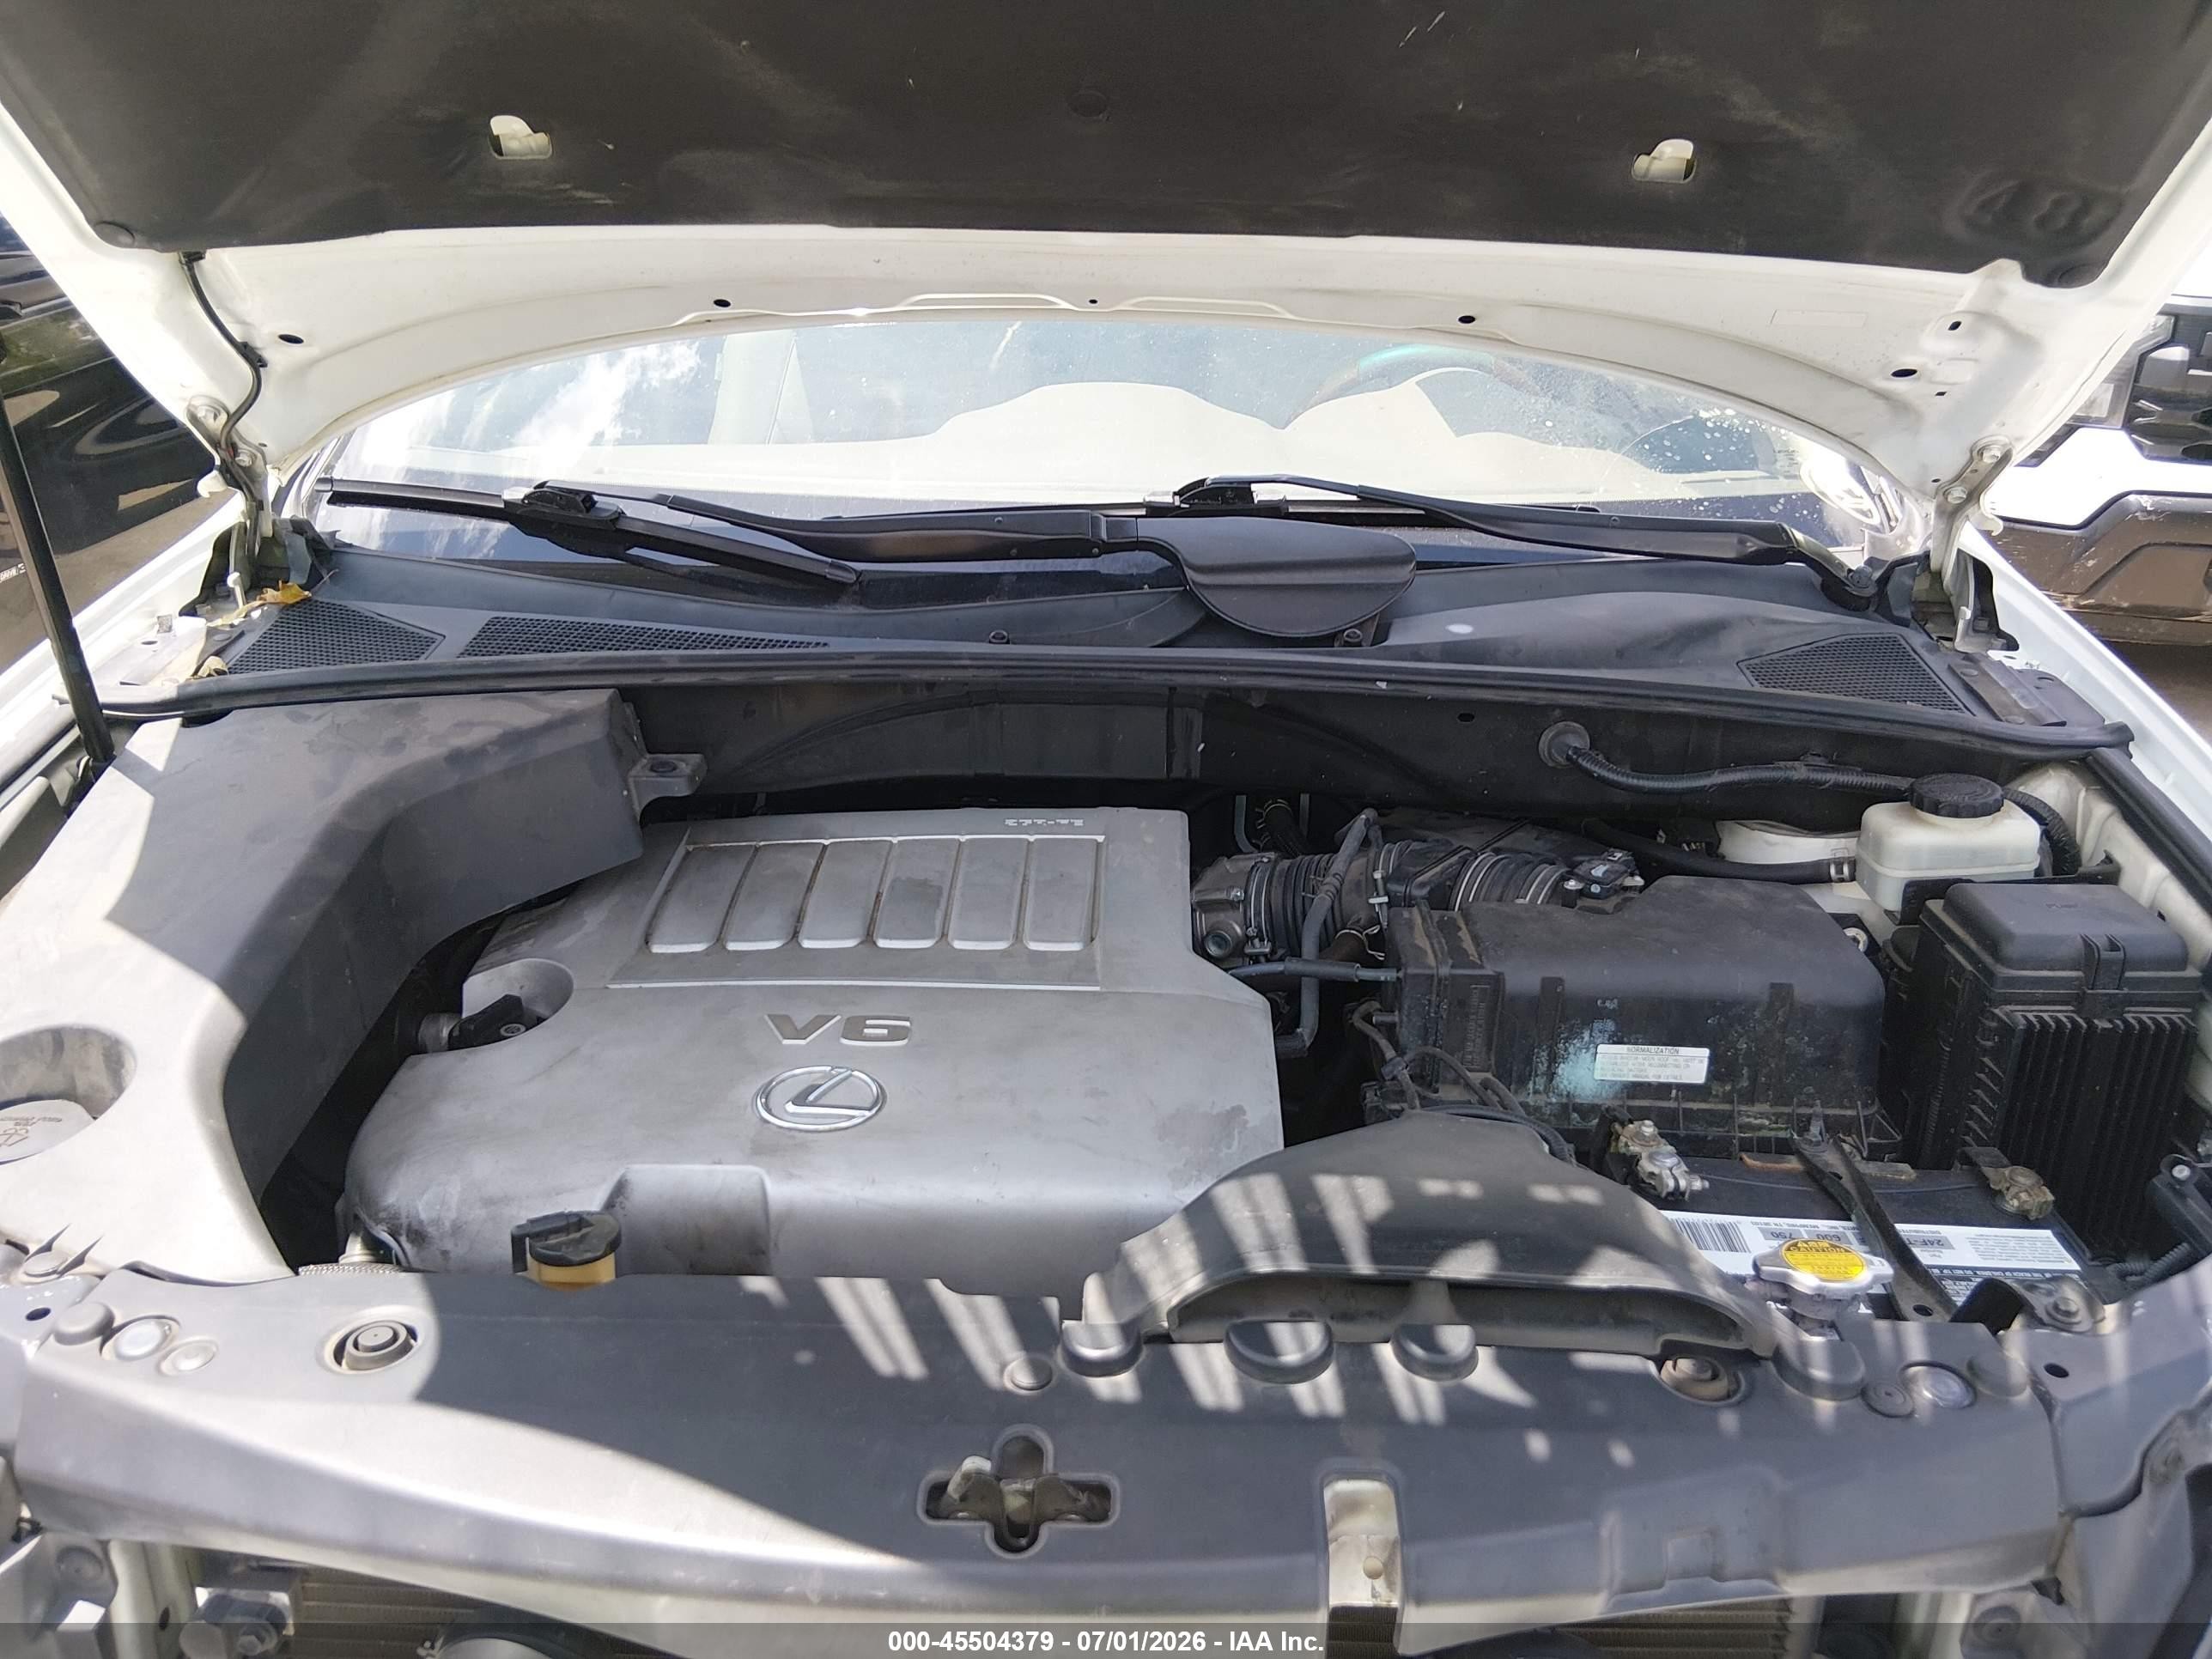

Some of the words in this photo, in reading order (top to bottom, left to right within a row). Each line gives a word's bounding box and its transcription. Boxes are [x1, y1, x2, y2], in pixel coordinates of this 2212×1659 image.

[763, 1013, 912, 1048] V6
[1626, 1046, 1680, 1055] NORMALIZATION
[1770, 1231, 1794, 1240] 750
[1816, 1233, 1841, 1242] 600
